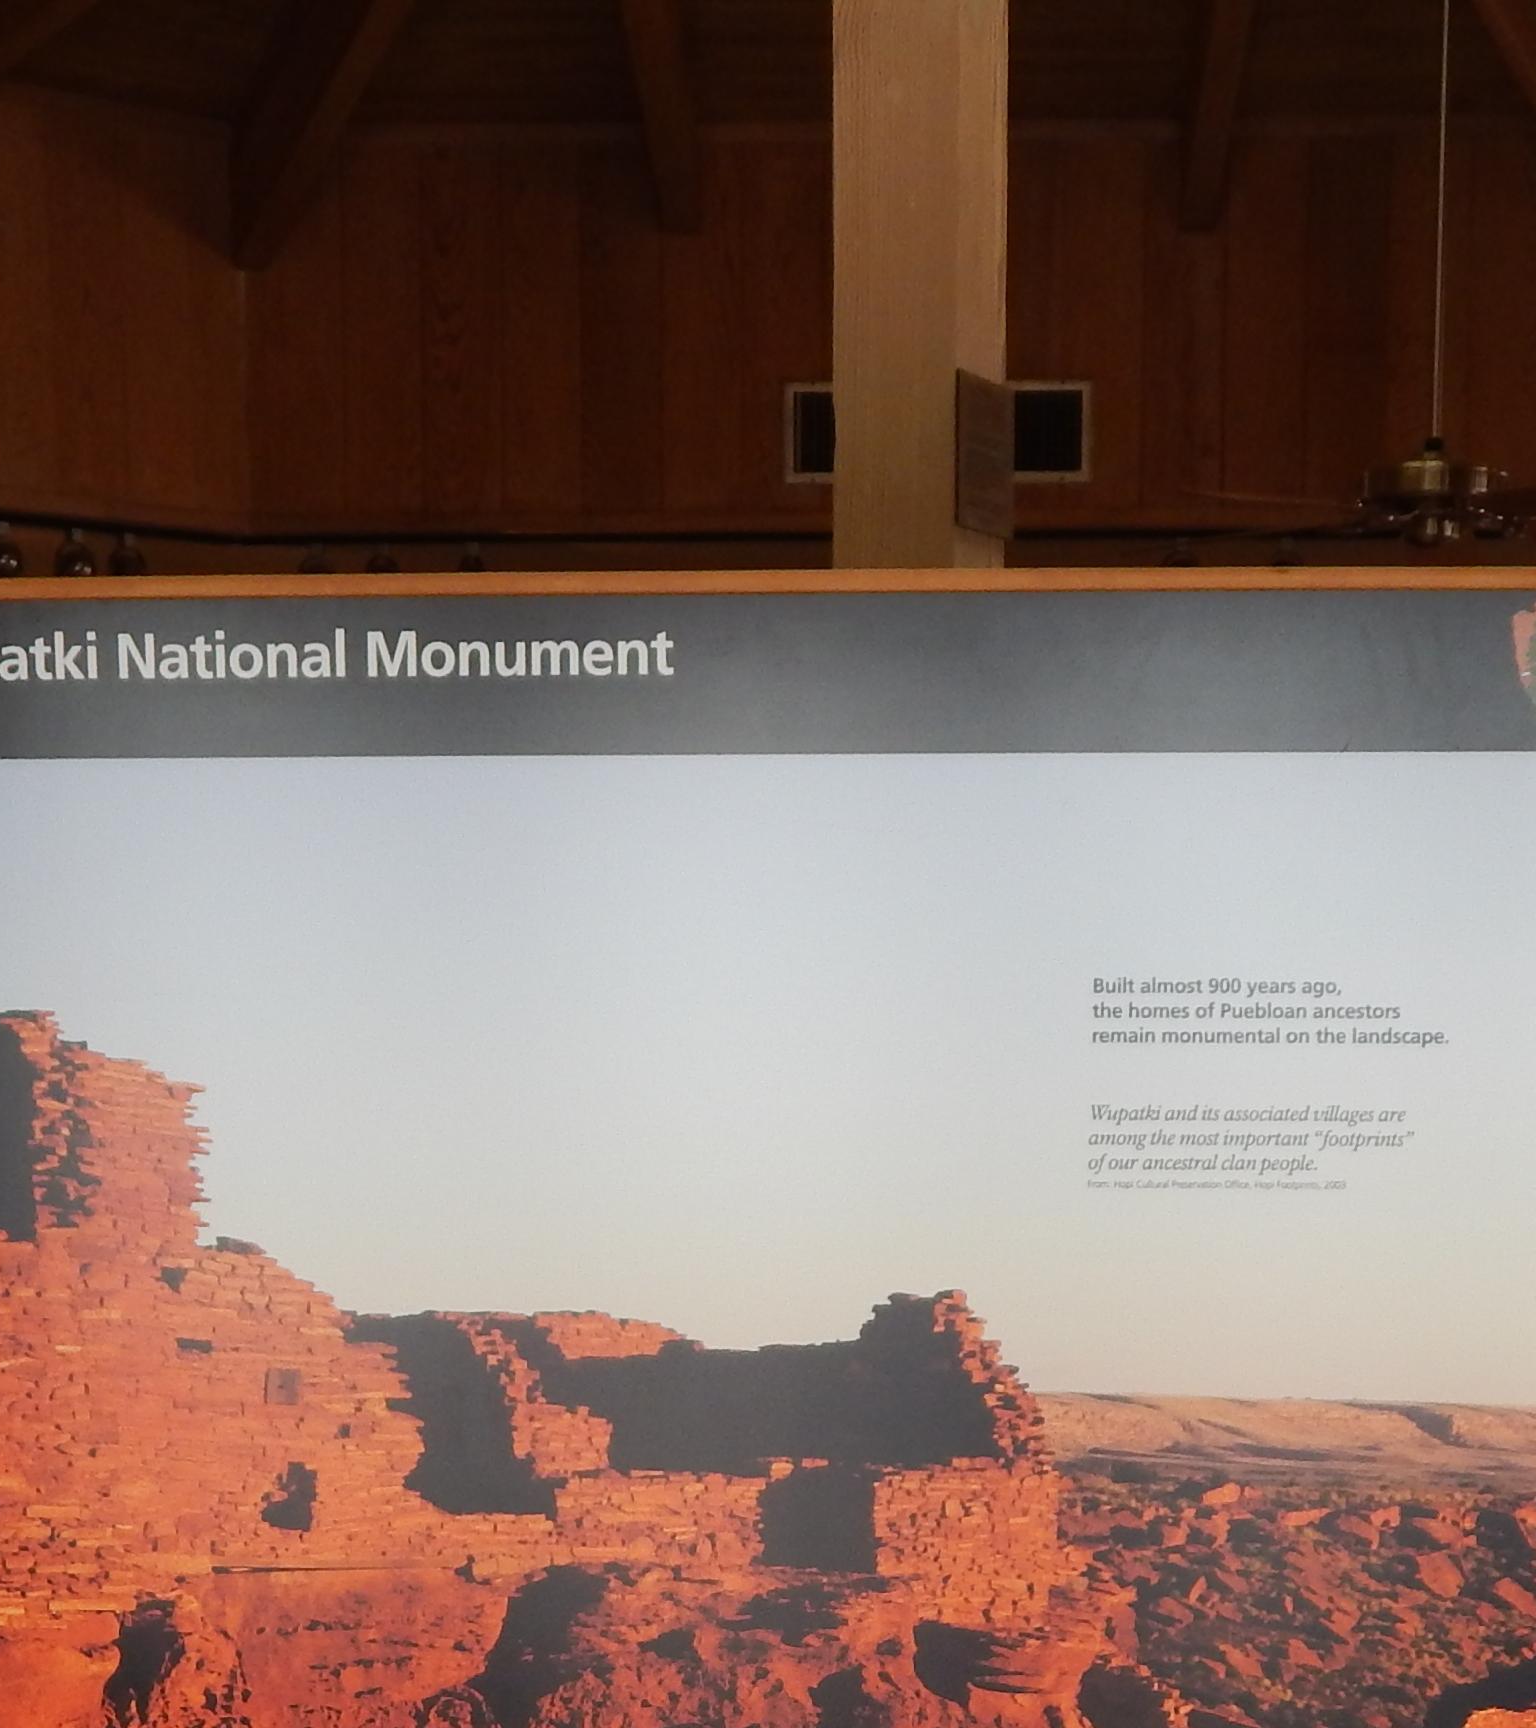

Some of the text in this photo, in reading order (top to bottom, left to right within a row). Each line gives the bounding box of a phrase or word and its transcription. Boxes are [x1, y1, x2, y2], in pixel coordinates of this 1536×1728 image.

[118, 628, 347, 680] National
[367, 629, 675, 678] Monument
[1093, 977, 1342, 997] Built almost 900 years ago,
[1092, 1003, 1401, 1019] the homes of Puebloan ancestors
[1092, 1027, 1449, 1048] remain monumental on the landscape.
[1091, 1104, 1406, 1126] Wupatki and its associated villages are
[1088, 1130, 1309, 1150] among the most important
[1088, 1154, 1318, 1175] of our ancestral clan people.
